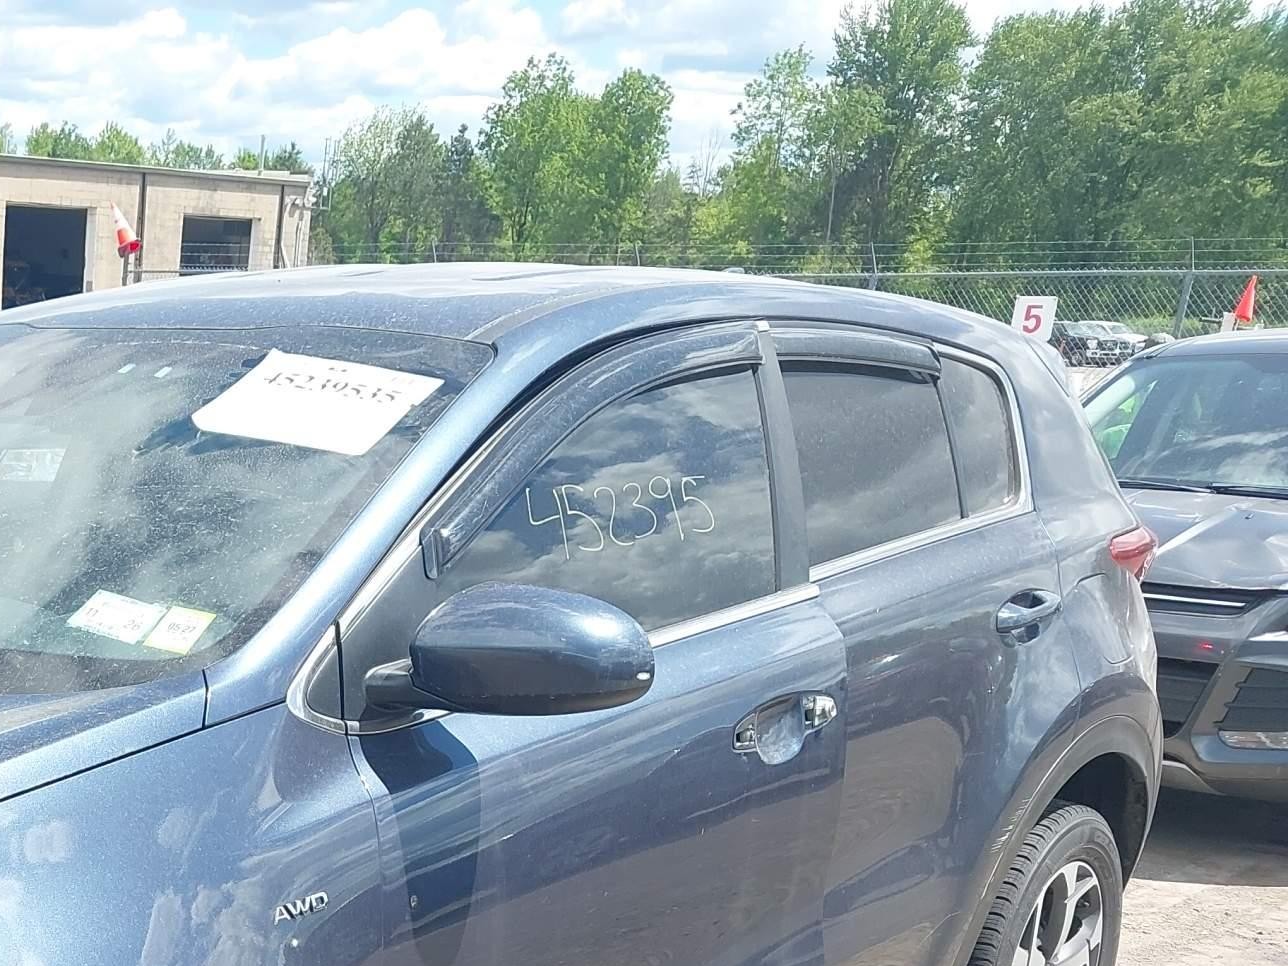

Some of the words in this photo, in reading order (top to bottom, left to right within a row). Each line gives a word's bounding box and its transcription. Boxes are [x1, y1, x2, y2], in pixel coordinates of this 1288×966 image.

[1022, 304, 1044, 334] 5
[525, 475, 715, 561] 452395
[273, 891, 329, 926] AWD
